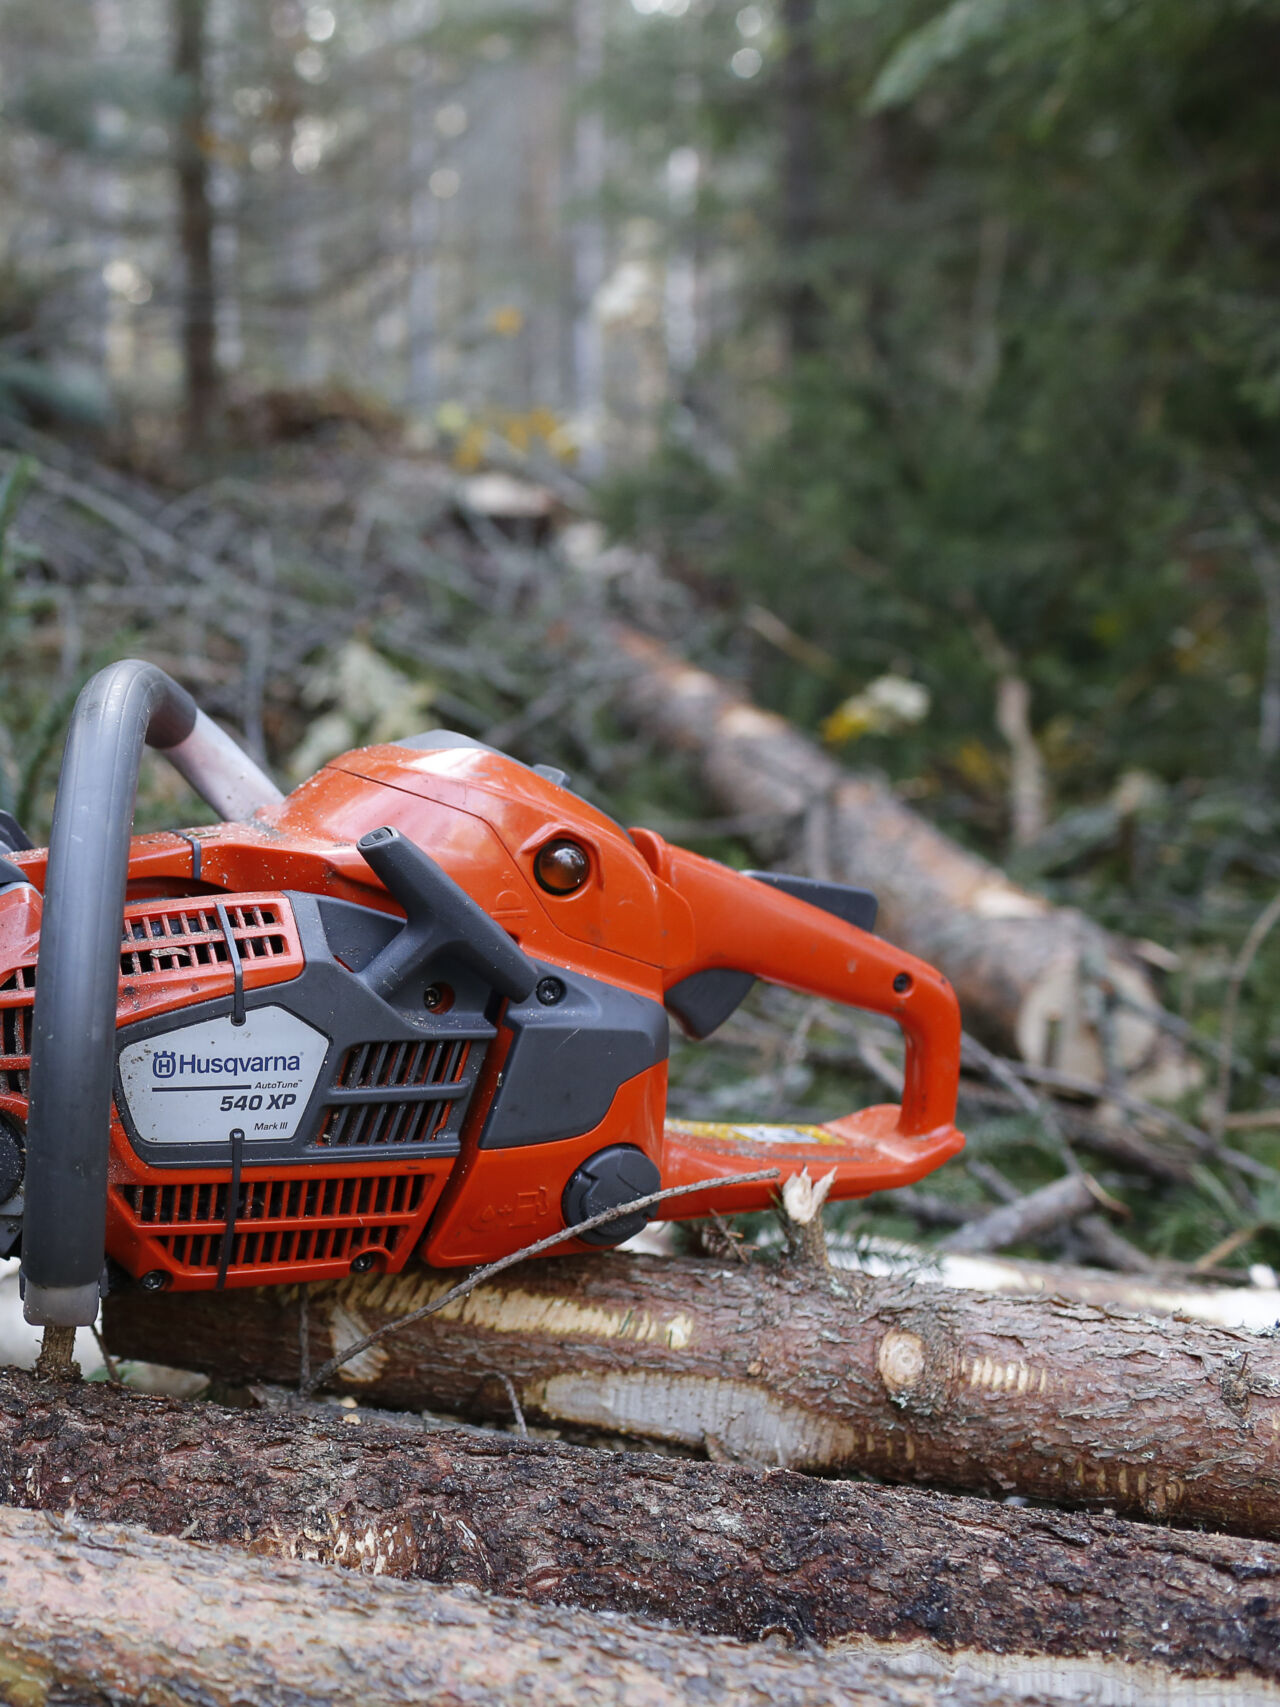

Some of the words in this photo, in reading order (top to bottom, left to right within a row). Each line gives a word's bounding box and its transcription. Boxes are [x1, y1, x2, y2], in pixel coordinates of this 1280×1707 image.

[179, 1054, 300, 1076] Husqvarna
[219, 1095, 263, 1112] 540
[266, 1093, 297, 1110] XP
[254, 1122, 278, 1131] Mark
[279, 1122, 288, 1130] III
